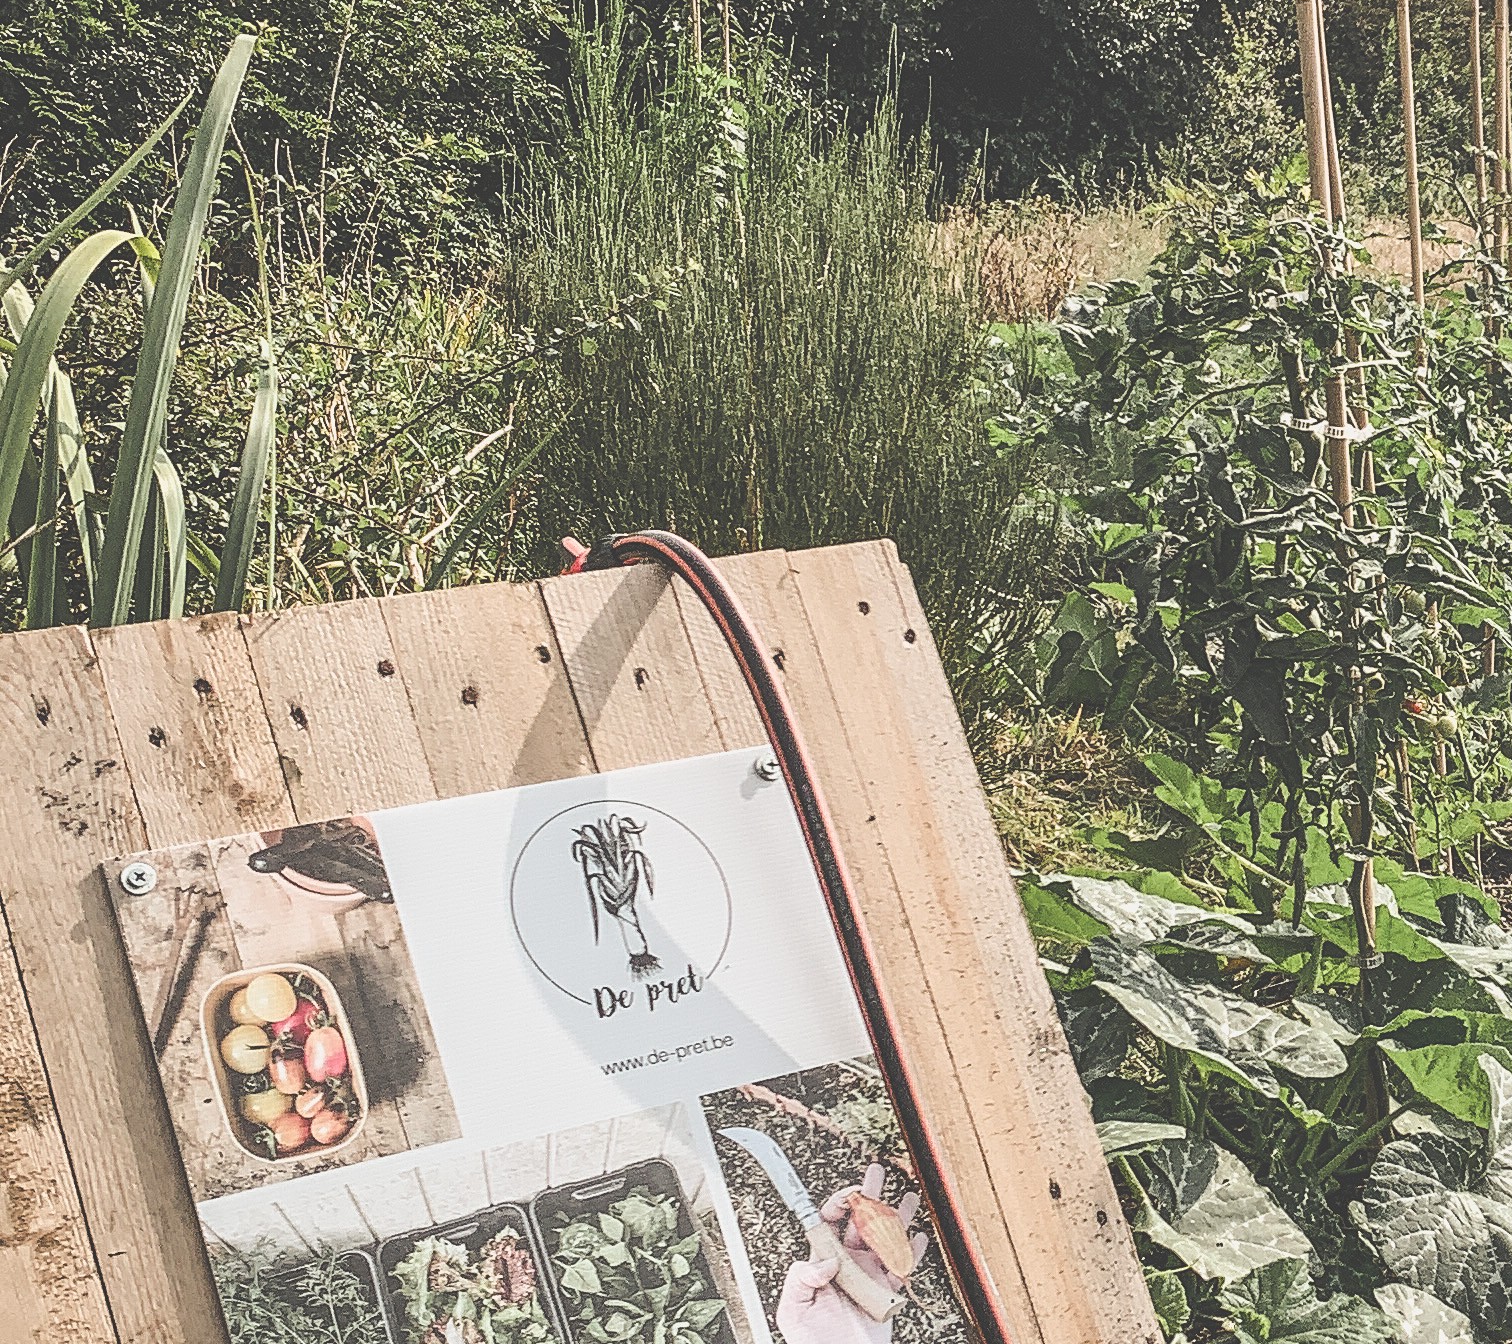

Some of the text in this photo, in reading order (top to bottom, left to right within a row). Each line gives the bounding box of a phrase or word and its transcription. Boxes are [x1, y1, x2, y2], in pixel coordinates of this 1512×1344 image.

[593, 964, 703, 1018] De pret
[600, 1034, 735, 1076] www.de-pret.be
